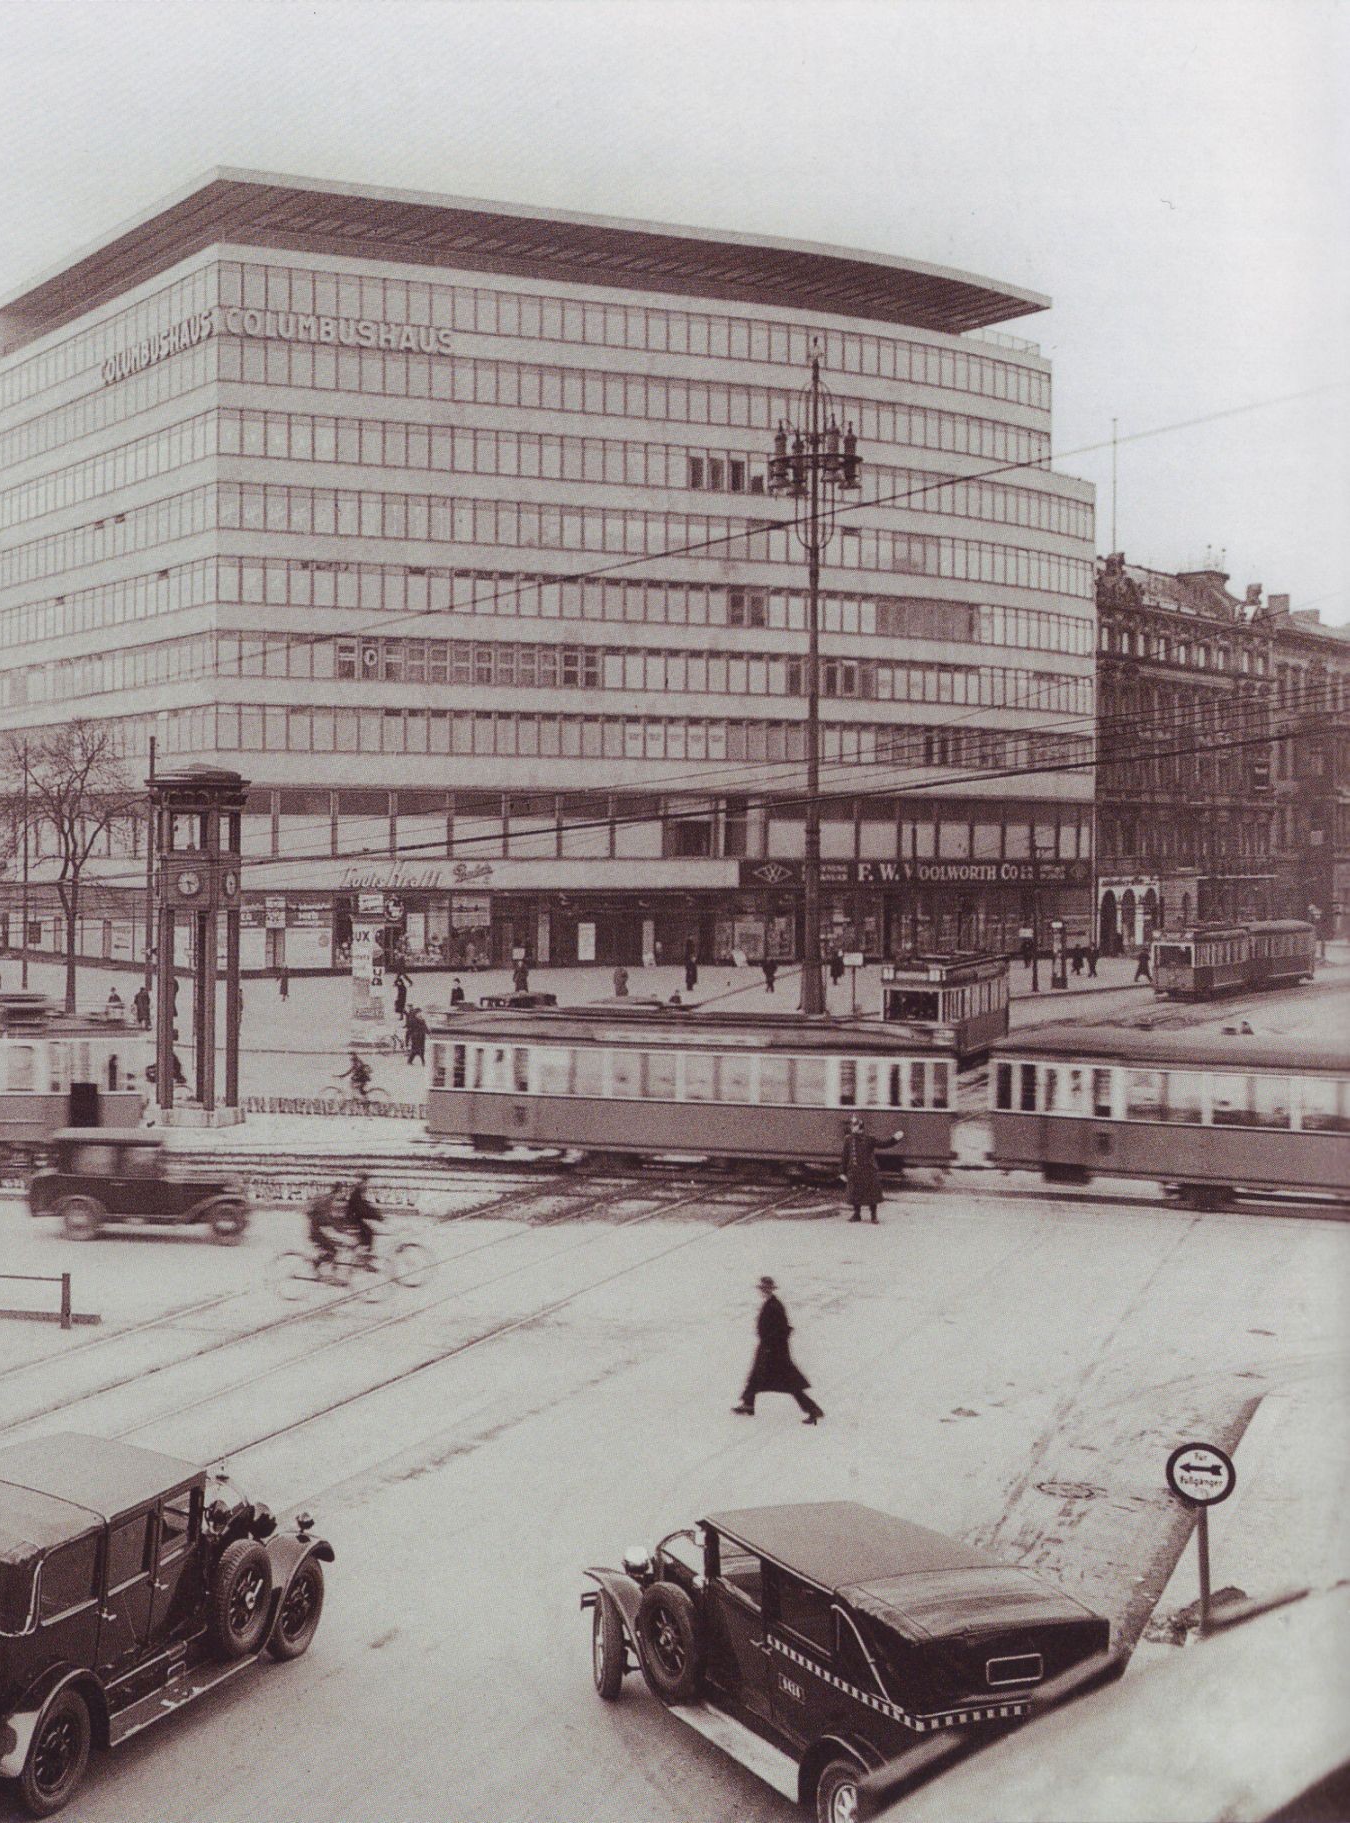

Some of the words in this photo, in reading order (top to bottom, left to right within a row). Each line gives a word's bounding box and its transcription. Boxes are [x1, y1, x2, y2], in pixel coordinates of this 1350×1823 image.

[102, 307, 214, 385] COLUMBUSHAUS
[224, 305, 453, 355] COLUMBUSHAUS
[857, 863, 874, 881] F.
[879, 863, 900, 881] W.
